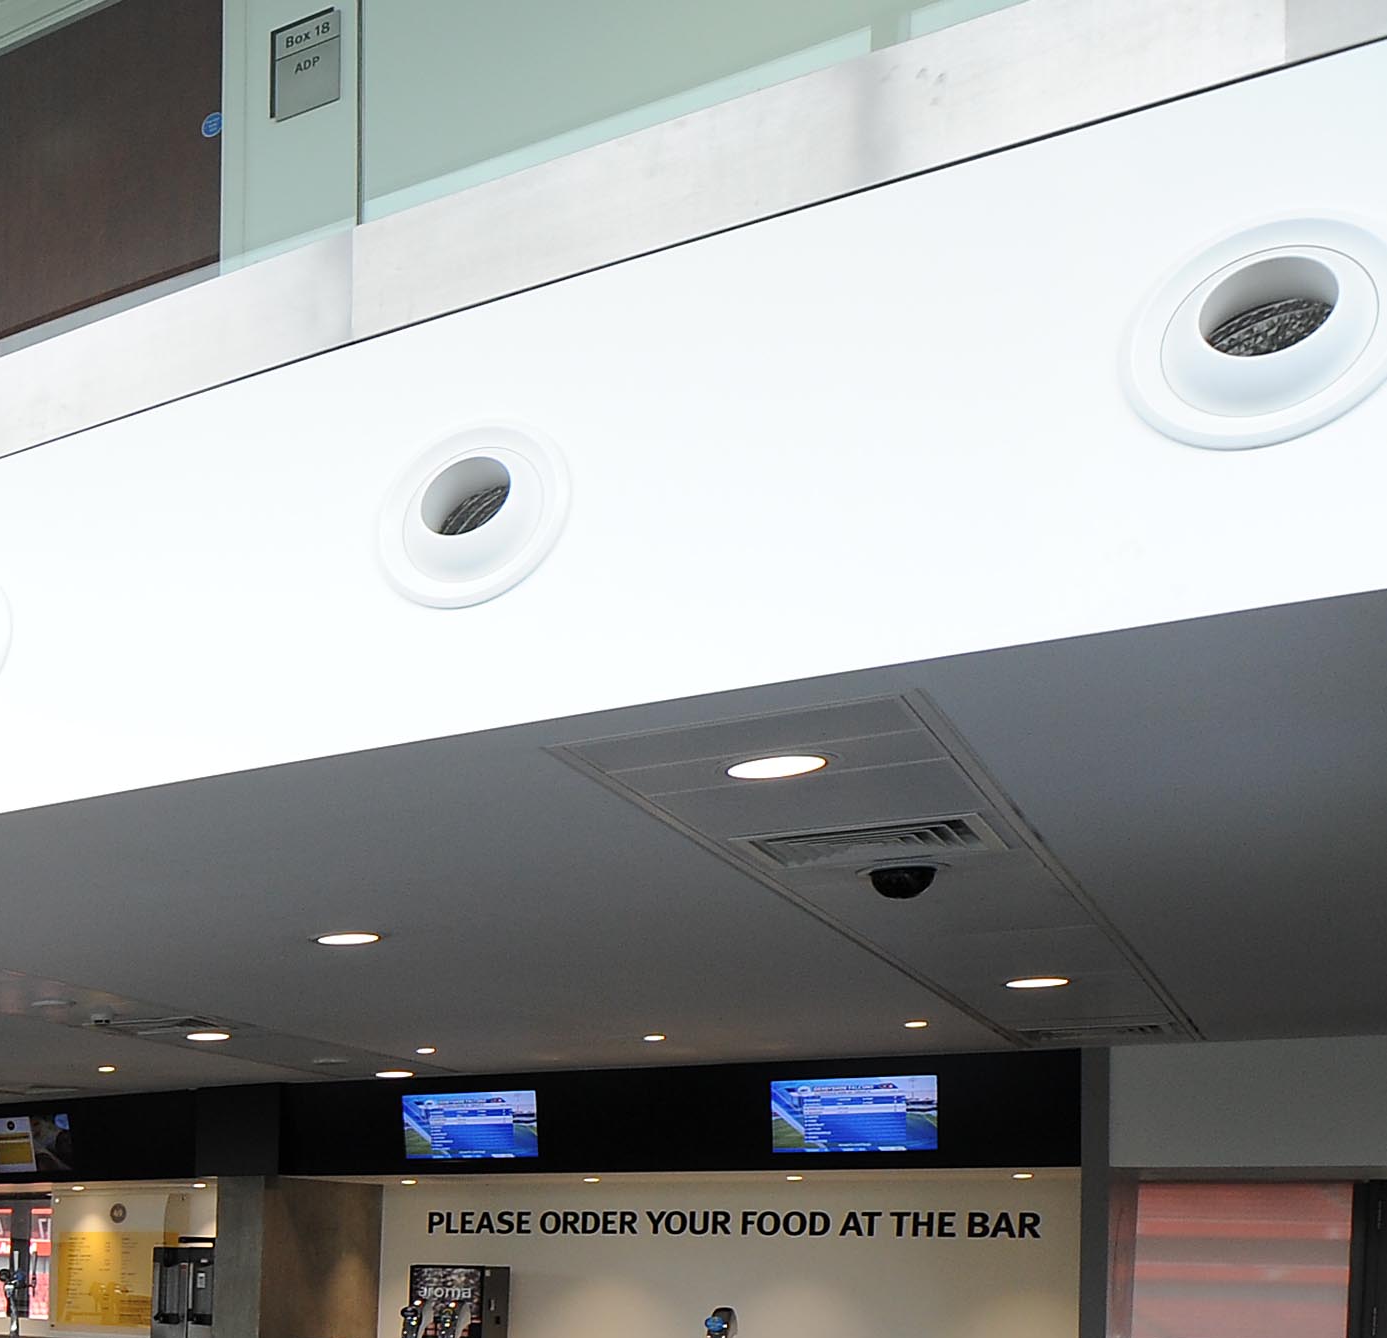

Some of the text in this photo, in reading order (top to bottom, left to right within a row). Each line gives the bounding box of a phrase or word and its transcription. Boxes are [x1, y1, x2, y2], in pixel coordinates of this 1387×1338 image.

[286, 22, 330, 48] Box 18
[295, 56, 320, 74] ADP
[427, 1211, 1041, 1238] PLEASE ORDER YOUR FOOD AT THE BAR
[418, 1286, 472, 1299] aroma
